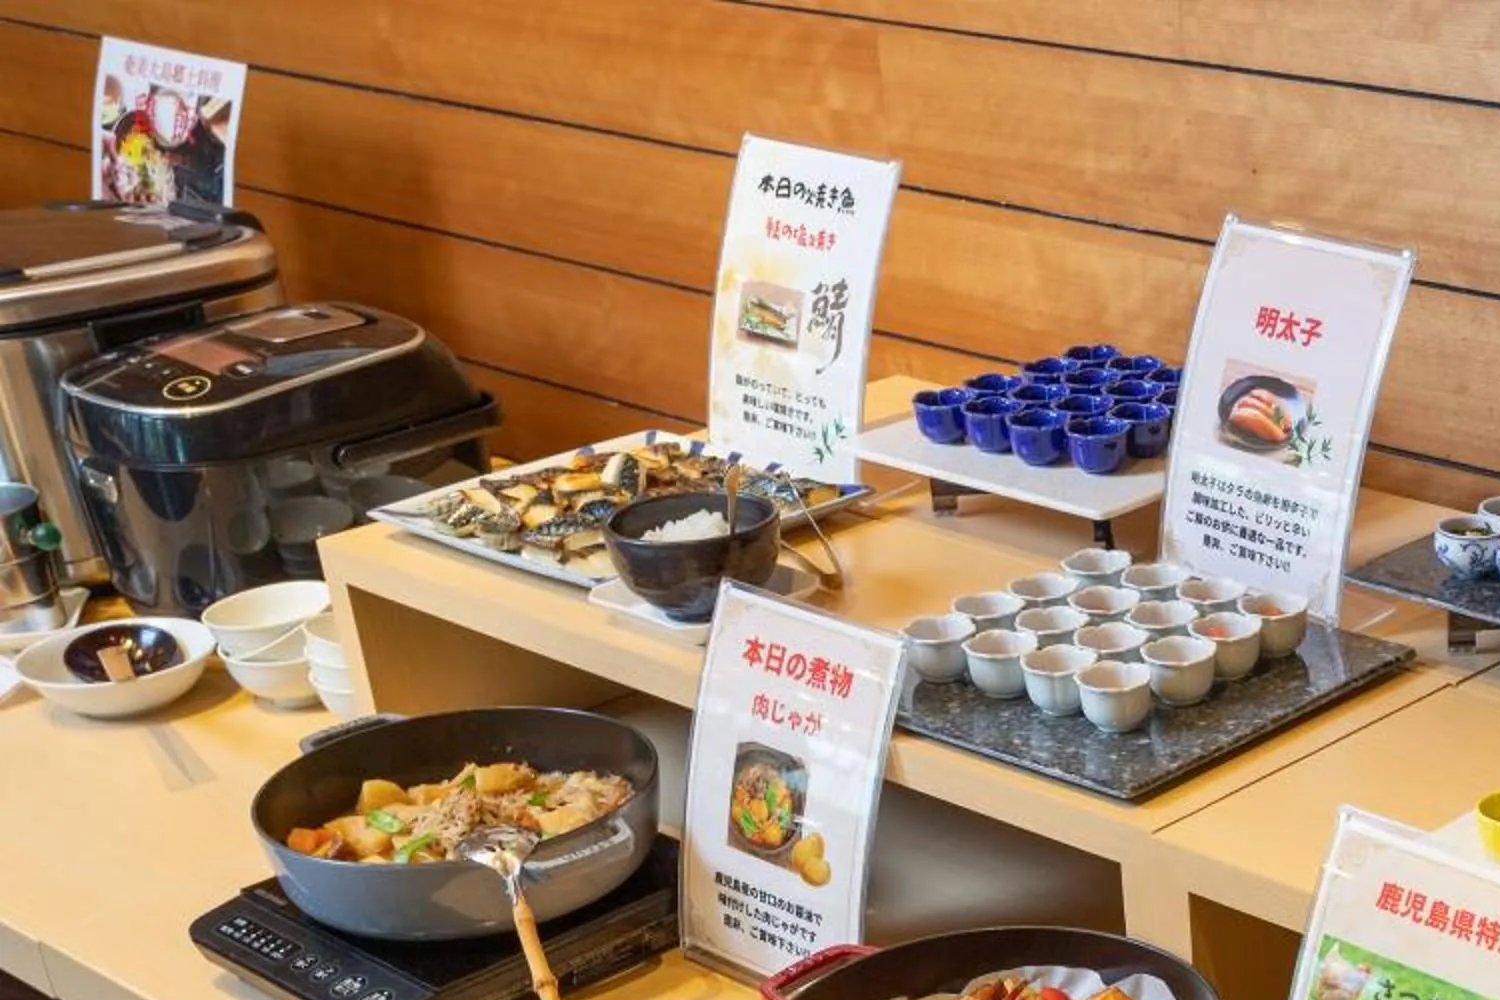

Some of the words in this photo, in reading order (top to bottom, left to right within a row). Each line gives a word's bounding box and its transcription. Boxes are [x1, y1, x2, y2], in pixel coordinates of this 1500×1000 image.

[758, 174, 856, 215] 本日の焼き魚
[1255, 305, 1323, 346] 明太子
[742, 635, 855, 699] 本日の煮物
[751, 692, 823, 735] 肉じゃが
